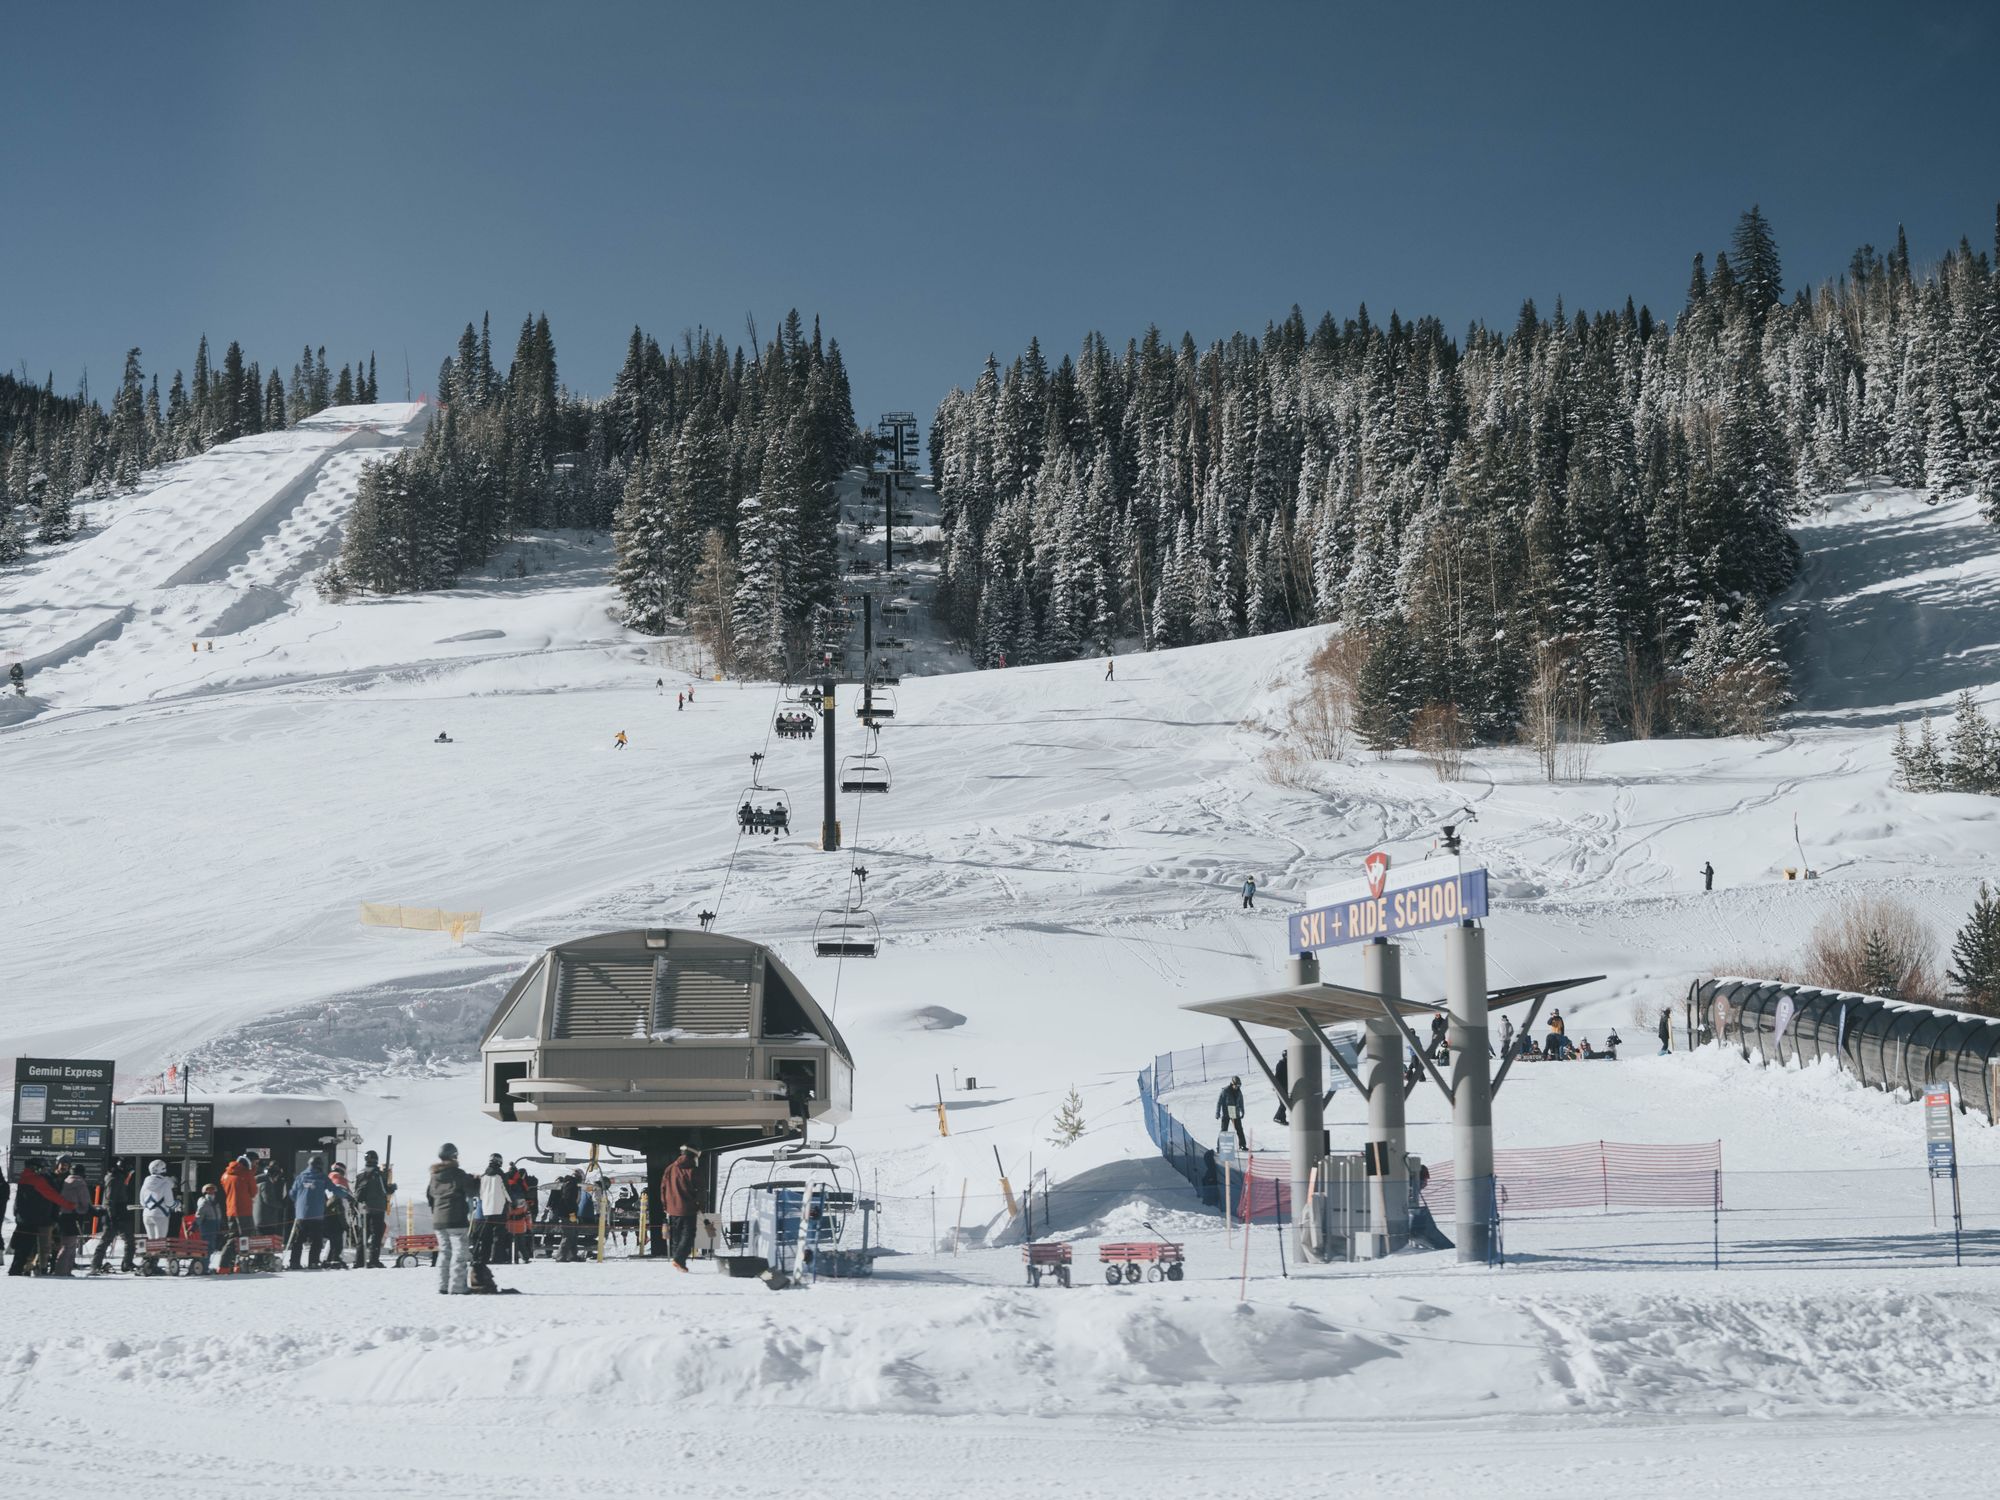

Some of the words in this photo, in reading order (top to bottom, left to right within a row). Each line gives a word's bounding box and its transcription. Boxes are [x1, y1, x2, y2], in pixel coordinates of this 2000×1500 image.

[1300, 911, 1326, 948] SKI
[1348, 897, 1388, 938] RIDE
[1394, 879, 1468, 928] SCHOOL
[28, 1065, 62, 1077] Gemini
[64, 1066, 103, 1079] Express
